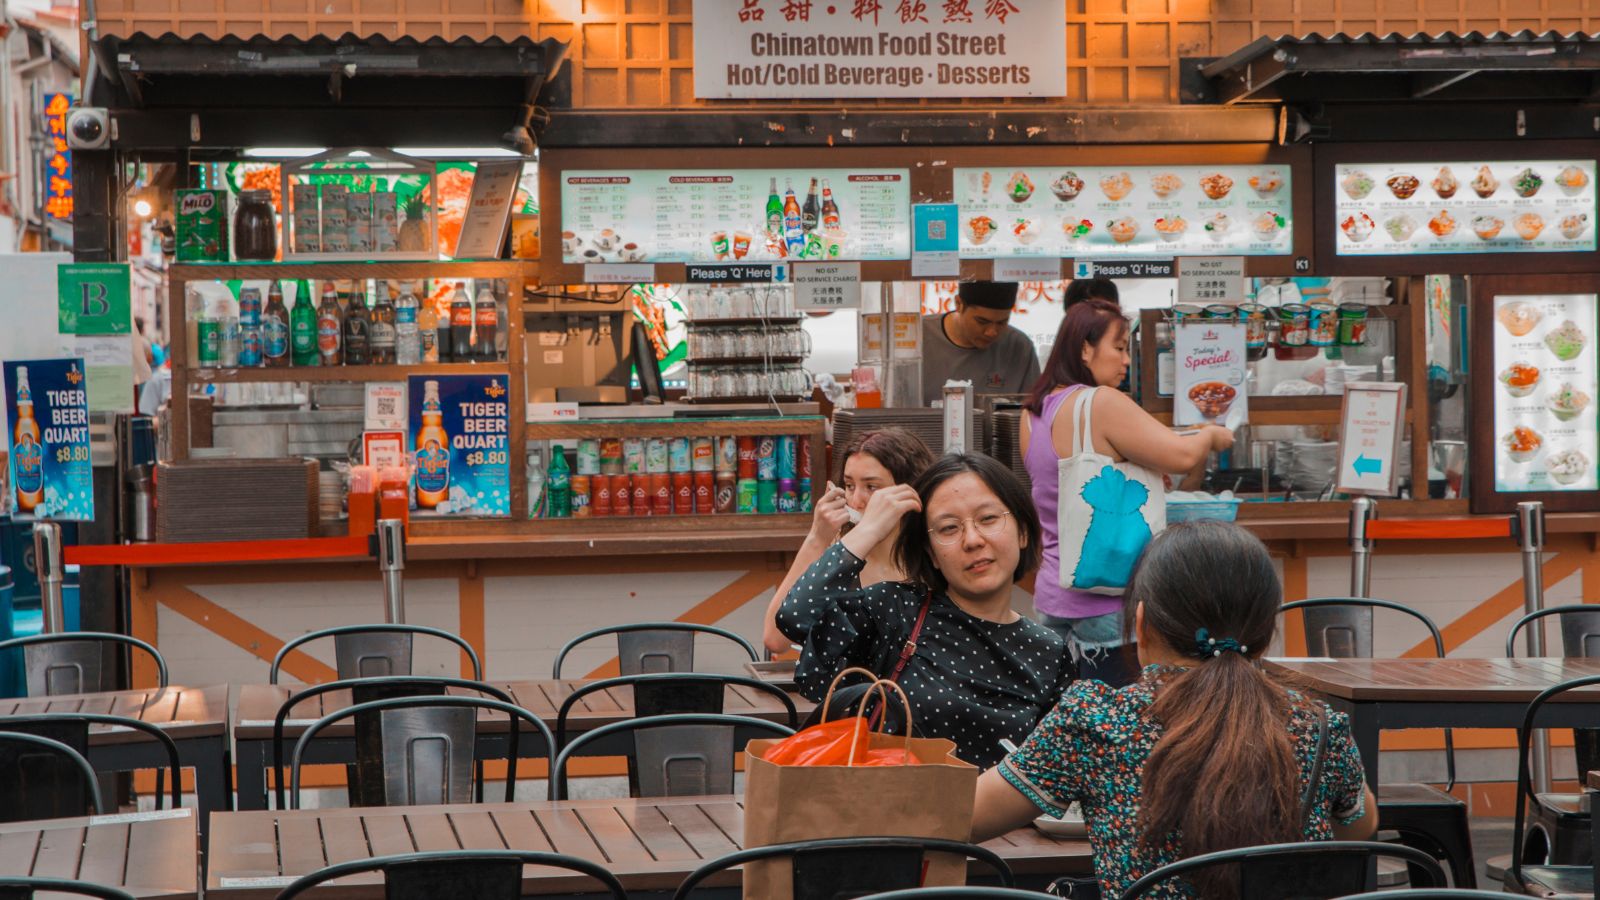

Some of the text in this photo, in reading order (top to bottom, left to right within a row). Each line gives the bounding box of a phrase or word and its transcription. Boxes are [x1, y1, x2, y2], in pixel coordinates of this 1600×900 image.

[751, 31, 1006, 56] Chinatown Food Street
[727, 63, 819, 86] Hot/Cold
[824, 63, 924, 87] Beverage
[937, 63, 1030, 85] Desserts
[184, 197, 212, 210] MILO
[691, 268, 727, 278] Please
[746, 267, 771, 278] Here
[1093, 264, 1127, 275] Please
[1145, 264, 1170, 274] Here
[1295, 259, 1309, 270] K1
[78, 282, 110, 317] B
[1184, 350, 1232, 371] Special
[46, 390, 85, 407] TIGER
[52, 408, 87, 425] BEER
[459, 402, 506, 417] TIGER
[464, 418, 507, 433] BEER
[44, 427, 88, 444] QUART
[453, 435, 507, 449] QUART
[56, 445, 88, 463] $8.80
[466, 451, 506, 466] $8.80
